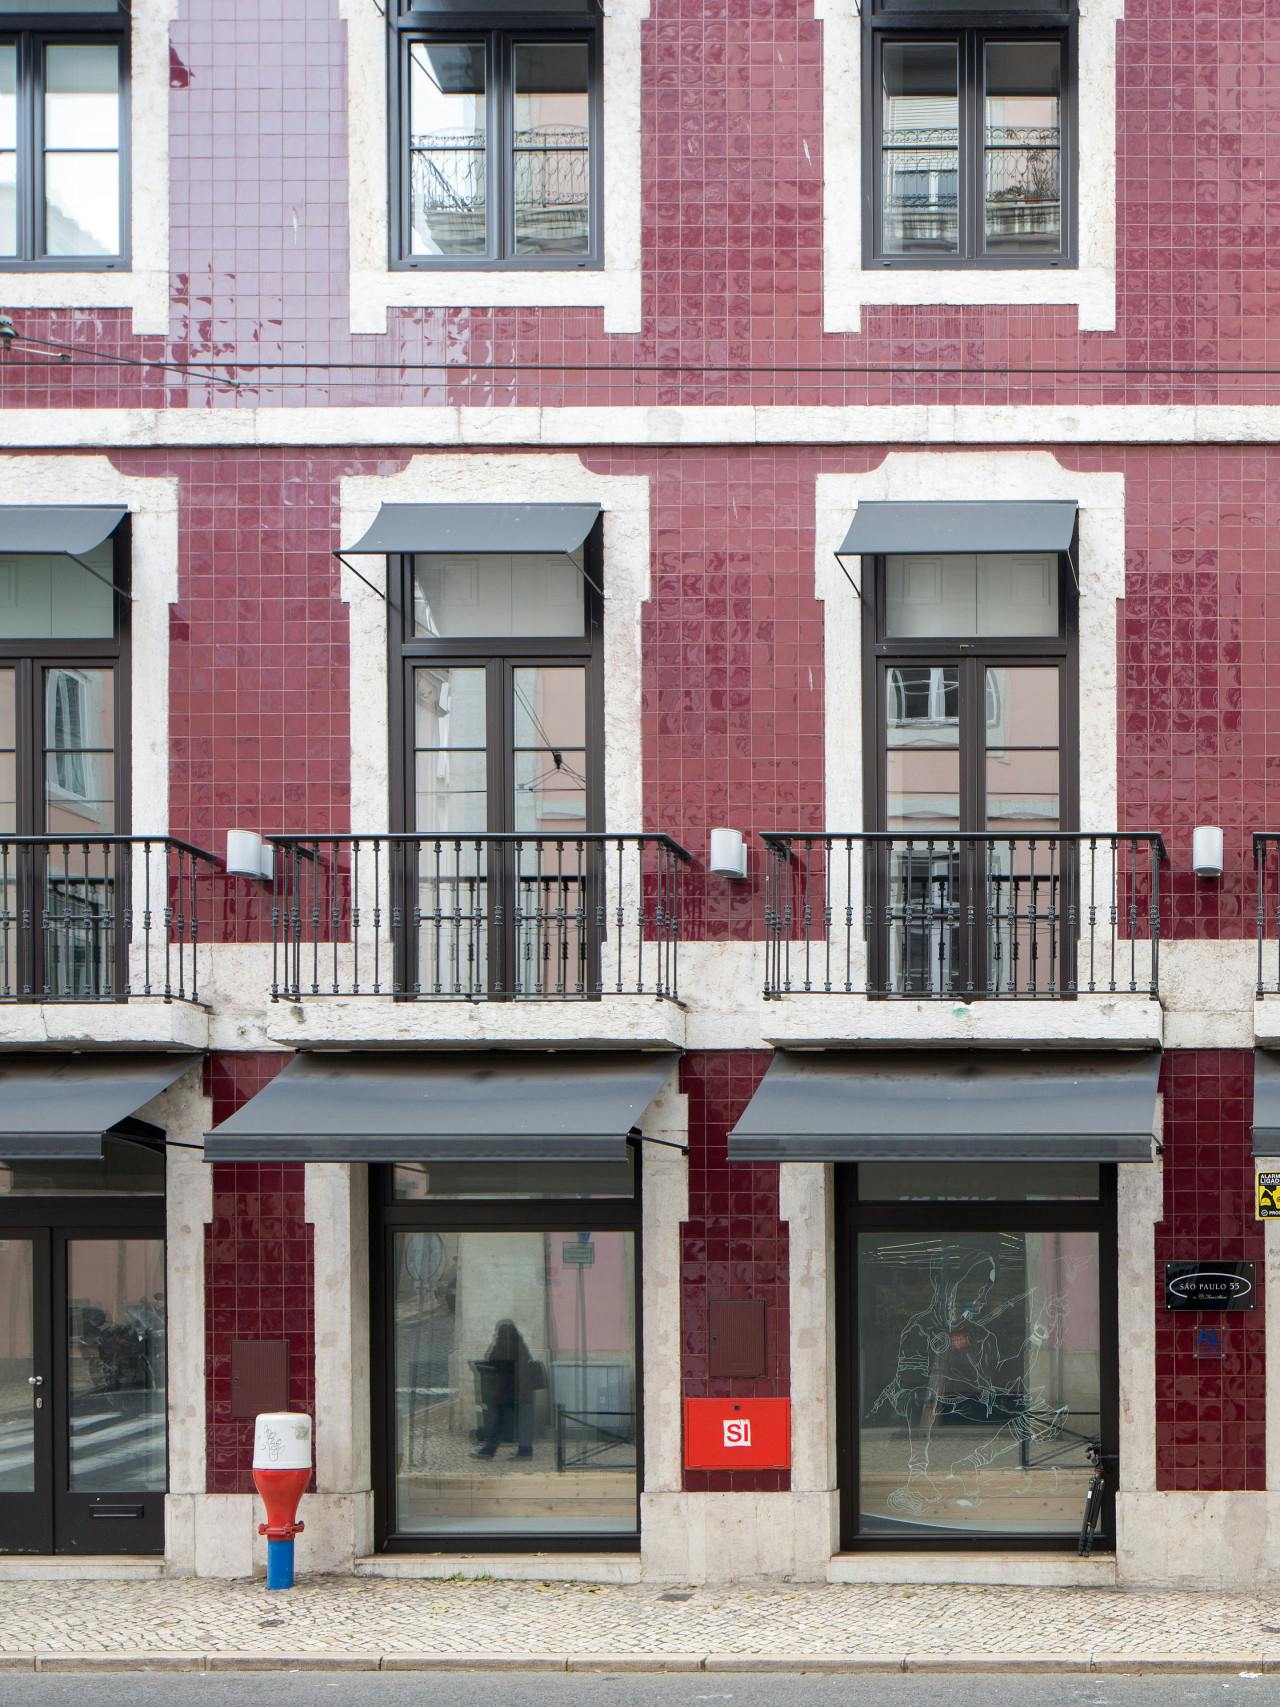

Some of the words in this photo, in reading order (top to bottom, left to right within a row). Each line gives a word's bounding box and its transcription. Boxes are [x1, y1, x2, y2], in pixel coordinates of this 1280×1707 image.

[1179, 1282, 1196, 1290] SÃO
[1229, 1282, 1240, 1290] 55
[1197, 1327, 1223, 1345] AL
[727, 1423, 748, 1442] SI
